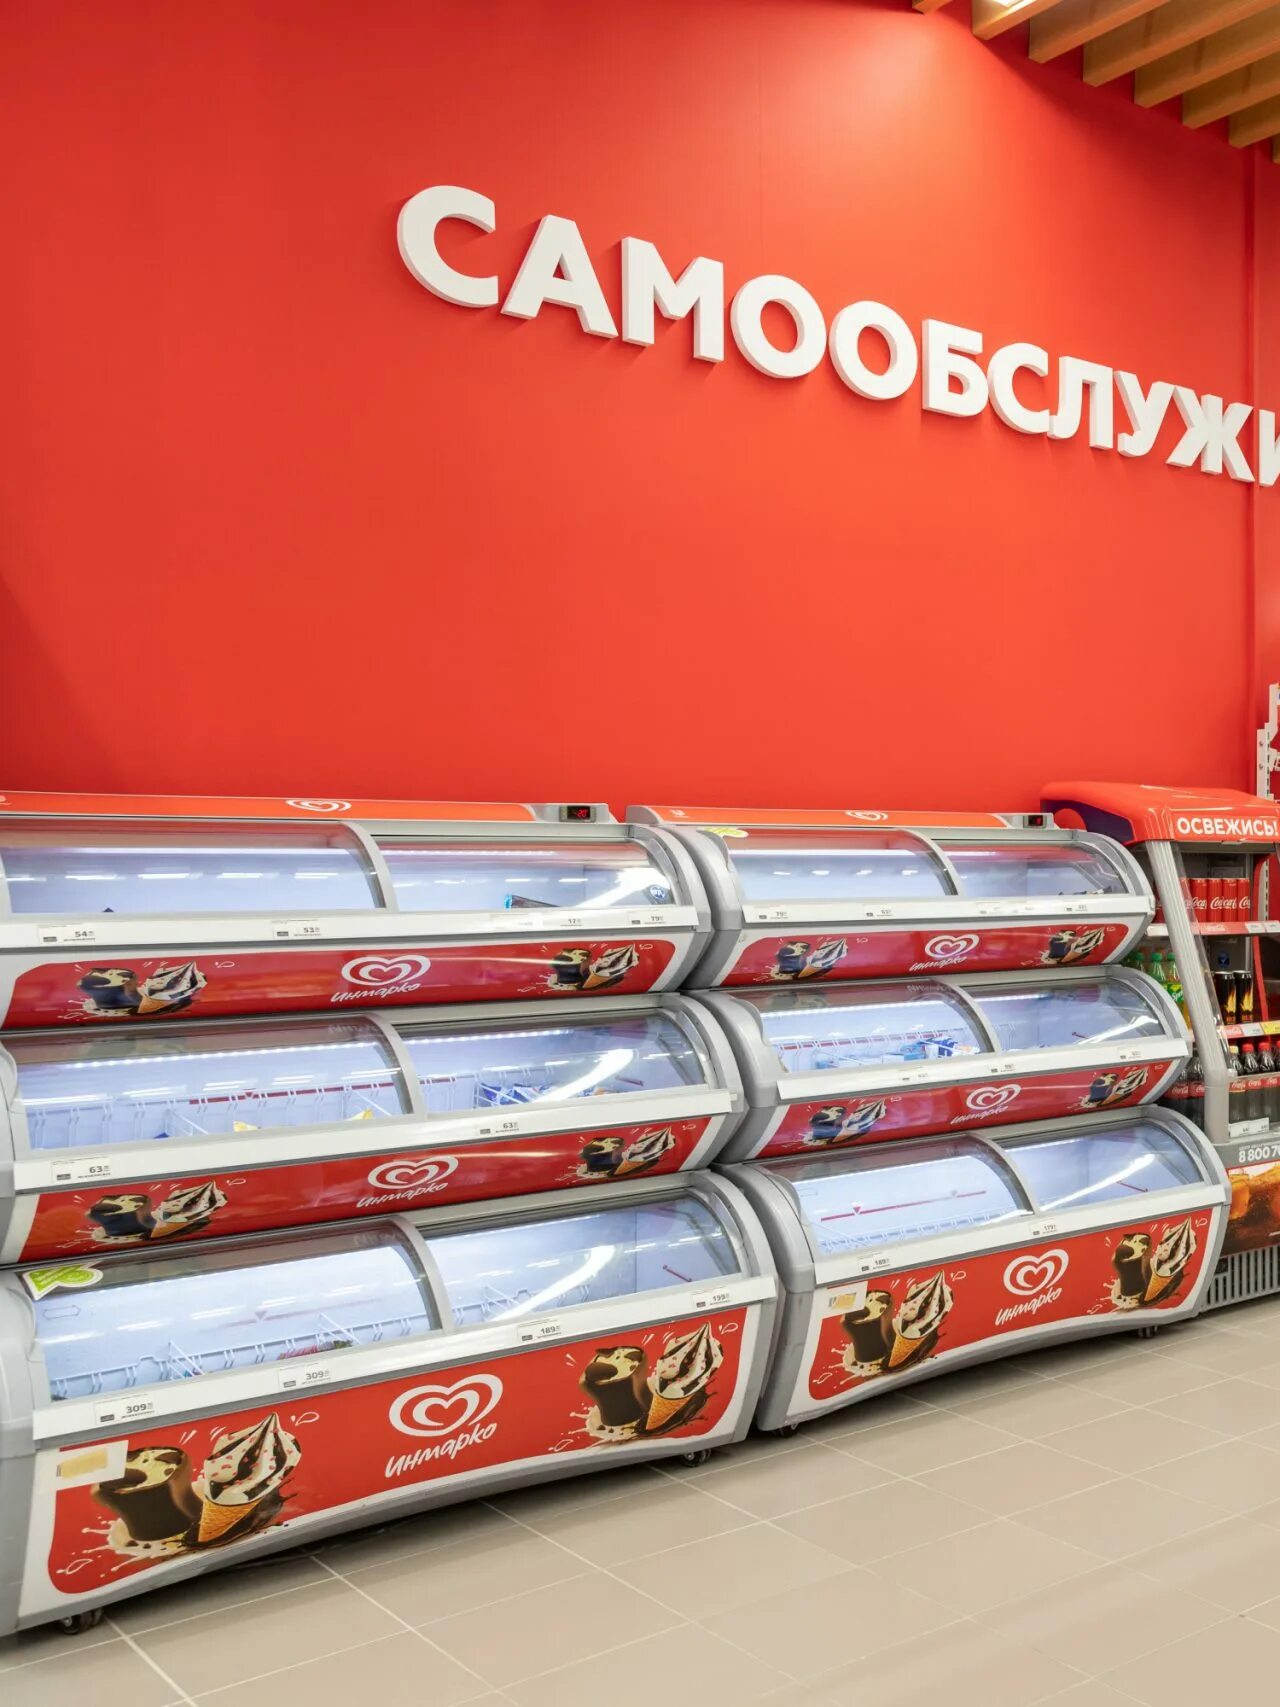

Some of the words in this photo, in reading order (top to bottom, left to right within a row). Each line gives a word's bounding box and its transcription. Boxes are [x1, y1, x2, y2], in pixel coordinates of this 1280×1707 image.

[1176, 816, 1279, 837] ОСВЕЖИСЬ!
[1238, 1150, 1246, 1163] 8
[1247, 1144, 1270, 1161] 800
